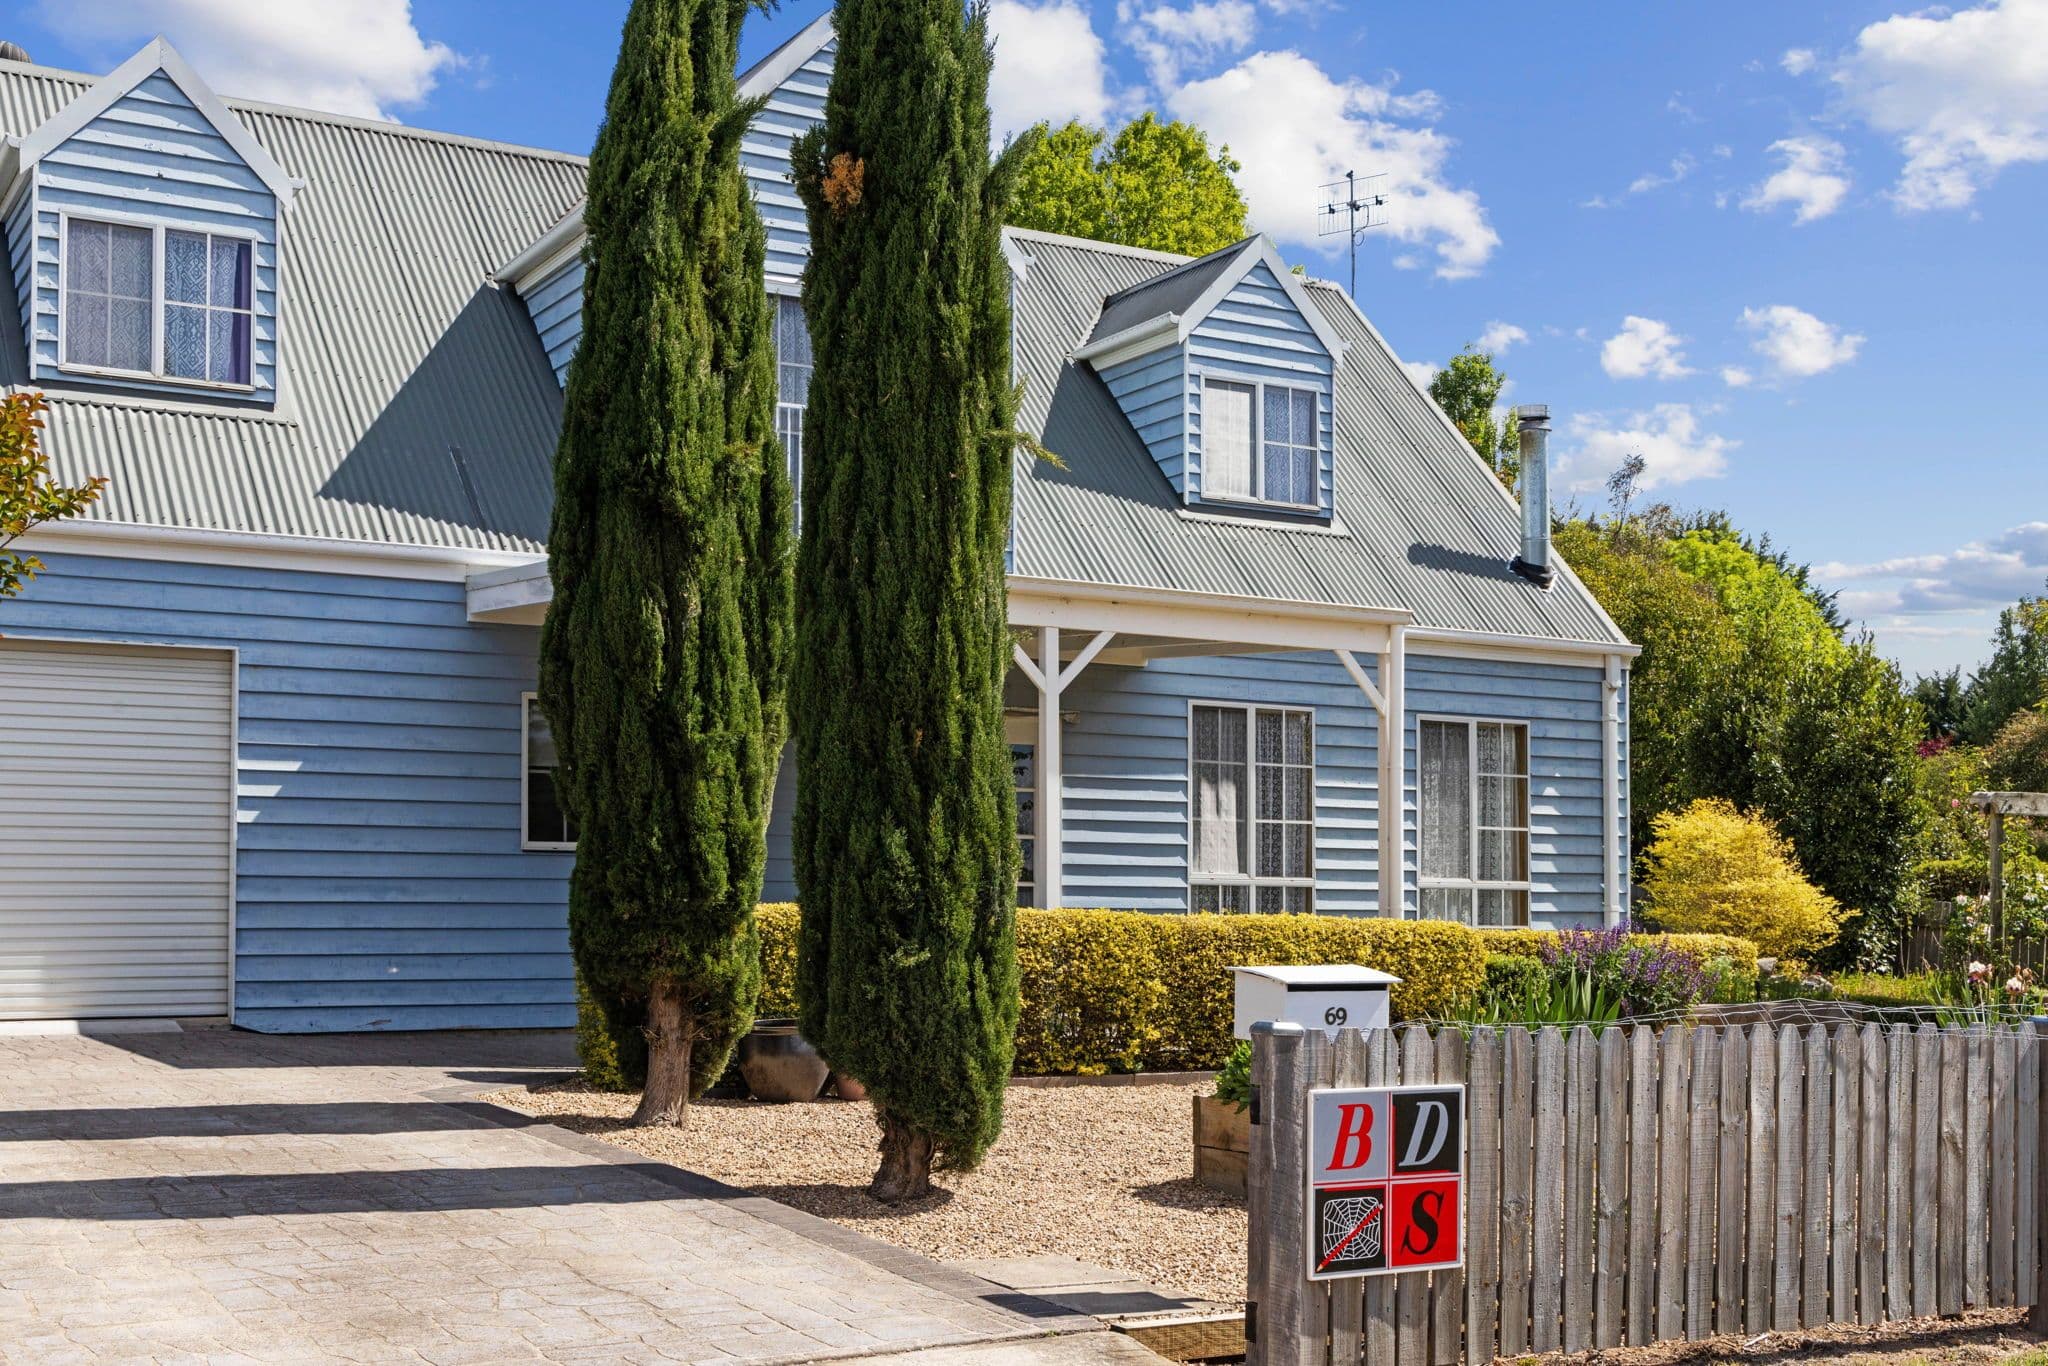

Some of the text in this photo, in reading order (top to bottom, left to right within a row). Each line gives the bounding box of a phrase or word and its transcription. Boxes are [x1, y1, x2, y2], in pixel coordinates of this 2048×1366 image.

[1325, 1006, 1347, 1026] 69
[1325, 1101, 1449, 1171] B D
[1402, 1191, 1444, 1255] S
